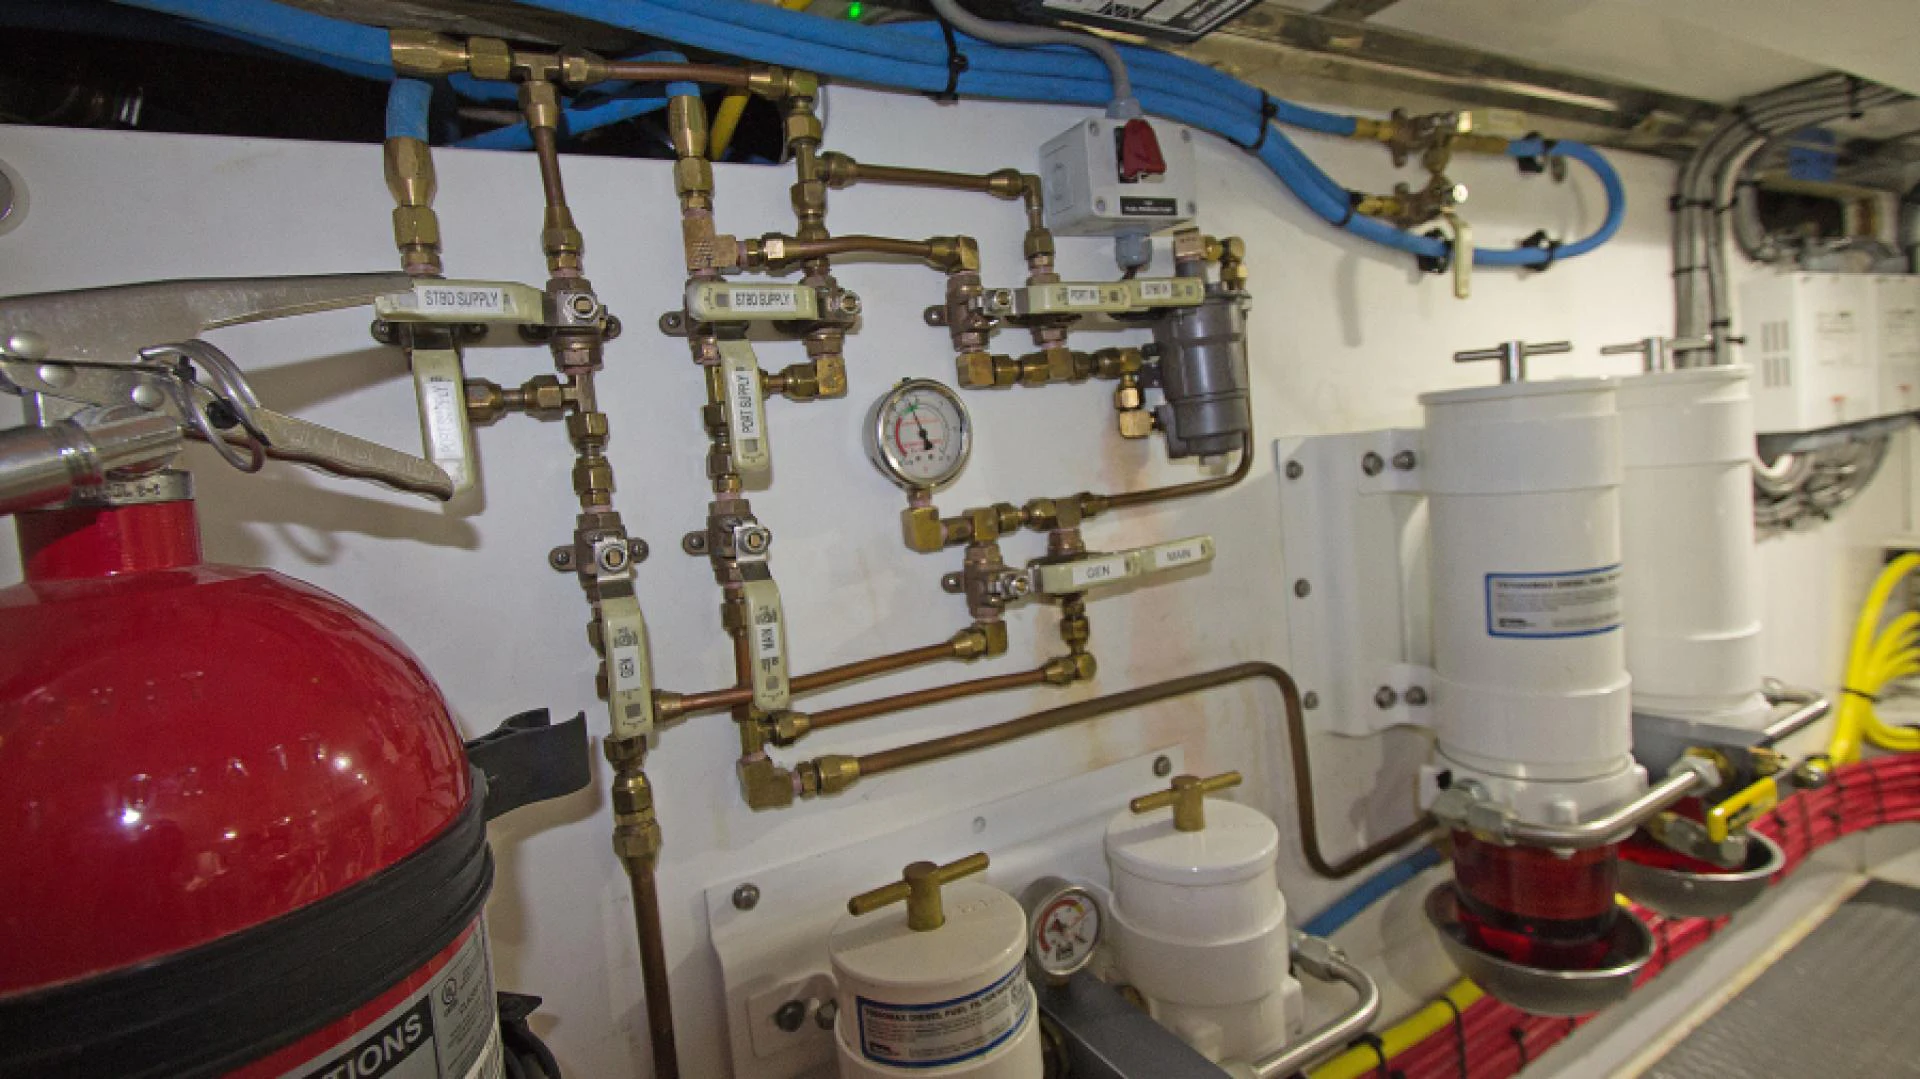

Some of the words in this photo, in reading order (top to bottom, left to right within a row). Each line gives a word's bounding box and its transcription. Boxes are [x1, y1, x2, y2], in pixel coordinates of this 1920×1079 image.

[424, 290, 455, 306] STBD
[456, 291, 498, 307] SUPPLY
[735, 291, 758, 306] STBD
[759, 292, 790, 306] SUPPLY
[735, 375, 752, 408] SUPPLY
[739, 409, 754, 433] PORT
[1166, 549, 1191, 561] MAIN
[1086, 565, 1110, 579] GEN
[618, 657, 634, 679] GEN
